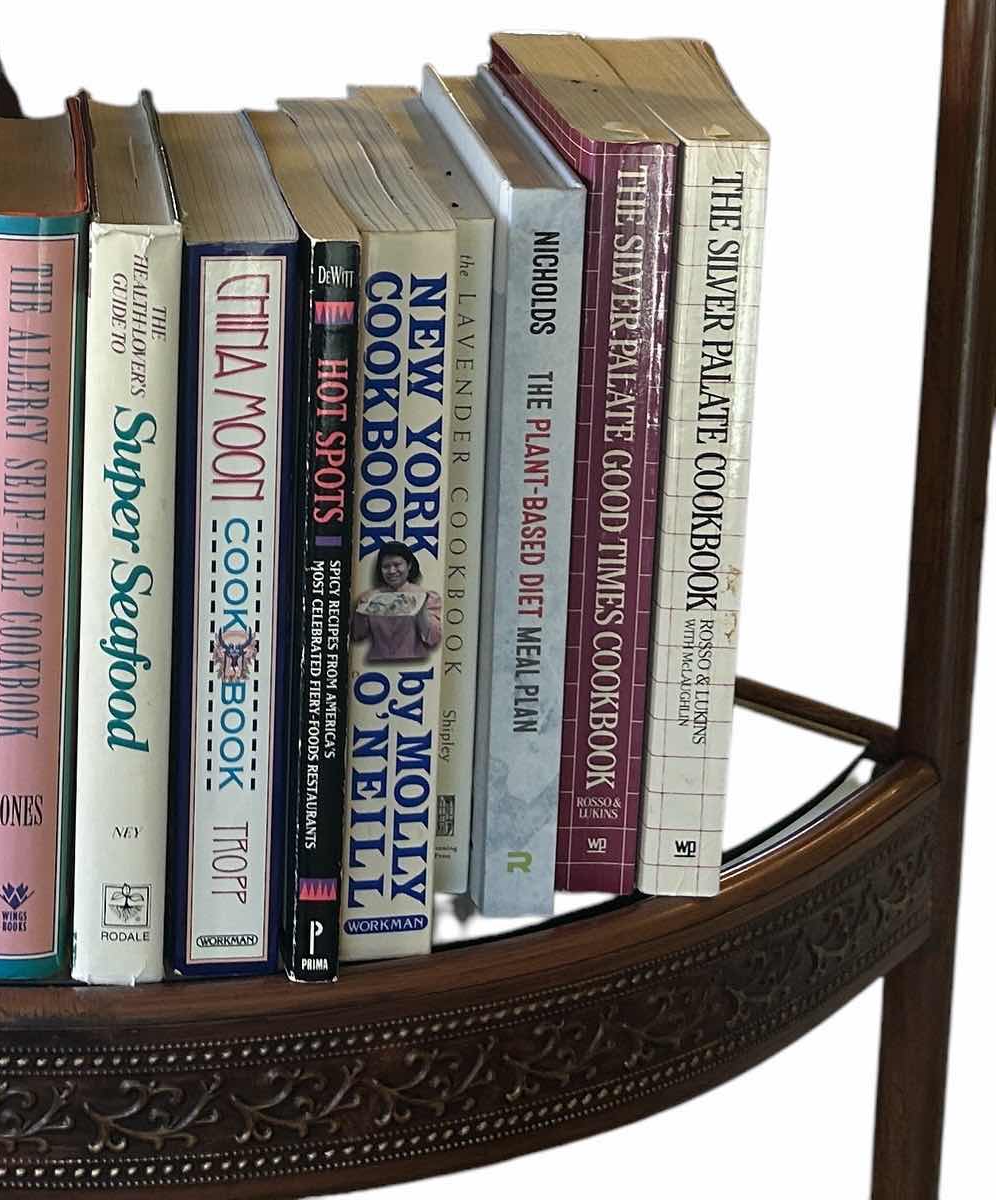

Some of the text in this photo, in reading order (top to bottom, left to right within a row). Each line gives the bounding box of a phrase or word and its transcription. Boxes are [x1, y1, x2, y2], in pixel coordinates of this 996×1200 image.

[5, 327, 50, 443] ALLERGY
[8, 263, 54, 313] THE
[212, 274, 270, 501] CHINA MOON
[530, 231, 560, 335] NICHOLDS
[313, 358, 348, 523] HOT SPOTS
[359, 272, 403, 562] COOKBOOK
[404, 272, 446, 560] NEW YORK
[445, 255, 476, 675] the LAVENDER COOKBOOK
[686, 172, 744, 611] THE SILVER PALATE COOKBOOK
[0, 458, 46, 597] SELF-HELP
[100, 406, 157, 752] Super Seafood
[513, 372, 553, 733] THE PLANT-BASED DIET MEAL PLAN
[305, 560, 324, 848] MOST CELEBRATED FIERY-FOODS RESTAURANTS
[325, 560, 341, 758] SPICY RECIPES FROM AMERICA'S
[212, 821, 249, 904] TROPP
[348, 671, 390, 909] O'NEILL
[389, 667, 434, 908] by MOLLY
[101, 931, 150, 941] RODALE
[302, 959, 328, 970] PRIMA
[348, 920, 423, 931] WORKMAN
